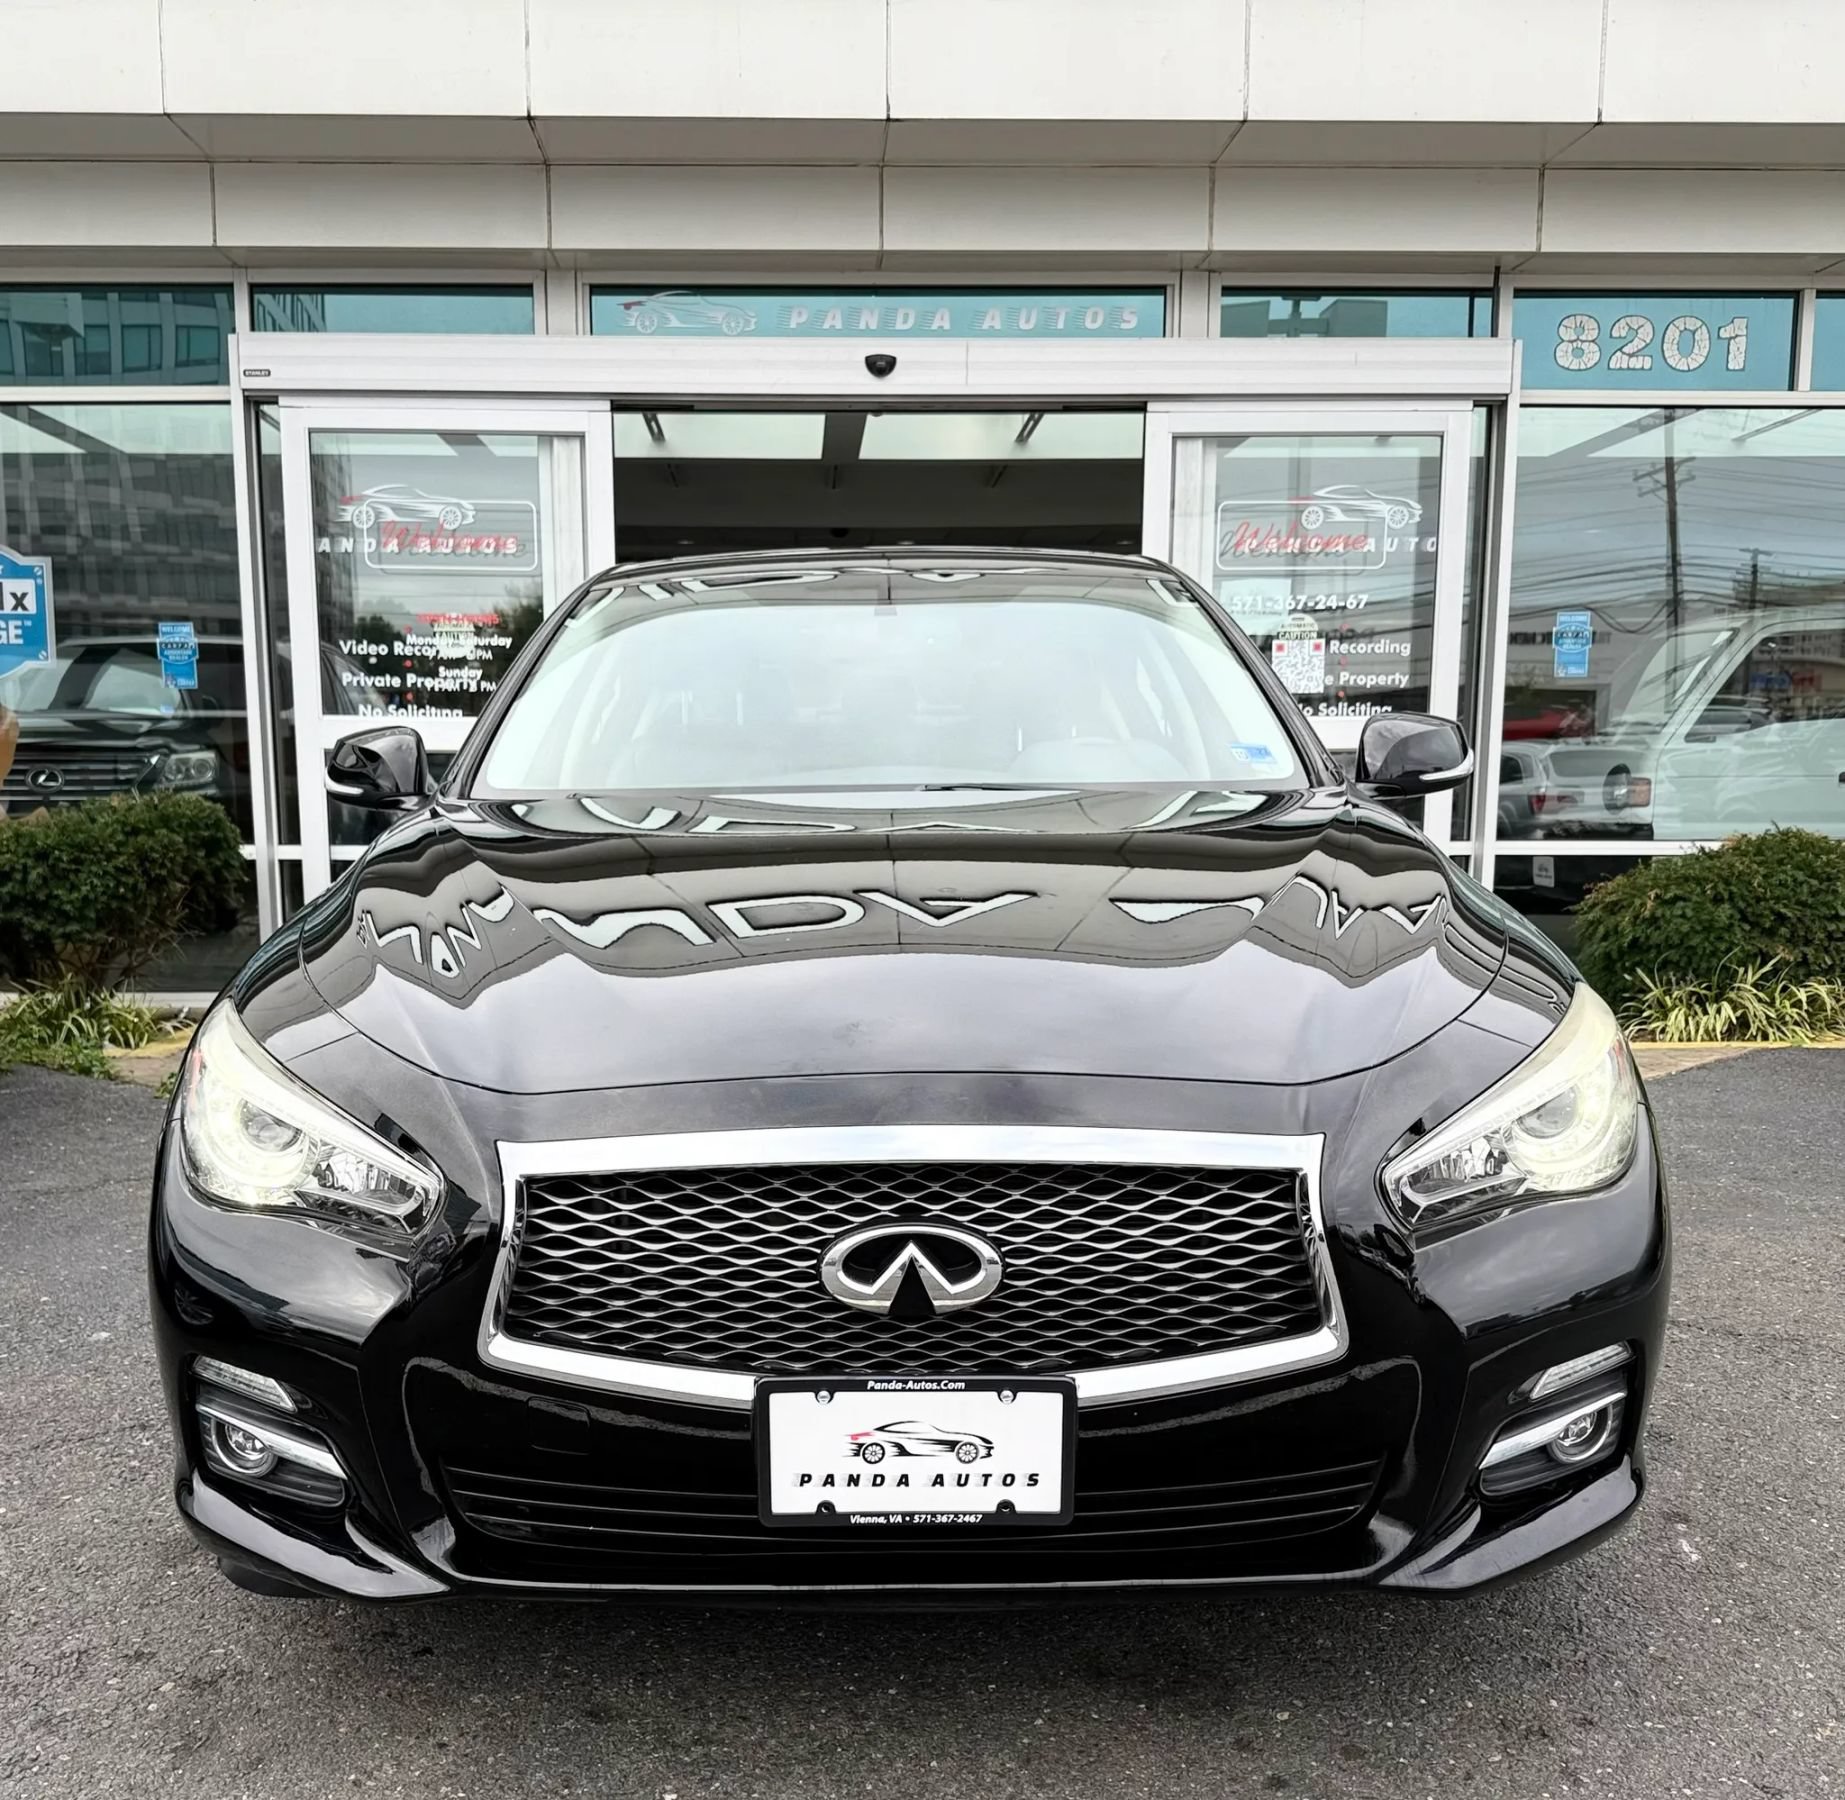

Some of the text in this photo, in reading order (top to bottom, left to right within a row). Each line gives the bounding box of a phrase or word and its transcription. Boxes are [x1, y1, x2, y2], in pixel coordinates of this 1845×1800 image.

[789, 307, 1139, 331] PANDA AUTOS
[1554, 313, 1749, 372] 8201
[1234, 521, 1368, 552] Welcome
[318, 537, 401, 554] ANDA
[1363, 537, 1436, 553] AUTO
[1232, 594, 1369, 610] 571-367-24-67
[1278, 631, 1318, 641] CAUTION
[339, 640, 389, 655] Video
[476, 649, 494, 660] PM
[1329, 639, 1411, 657] Recording
[438, 666, 483, 681] Sunday
[1339, 671, 1410, 688] Property
[342, 672, 401, 688] Private
[406, 672, 478, 692] Property
[358, 704, 383, 717] No
[867, 1380, 966, 1391] Panda-Autos.Com
[799, 1473, 1040, 1488] PANDA AUTOS
[850, 1514, 983, 1525] Vienna, VA 571-367-2467
